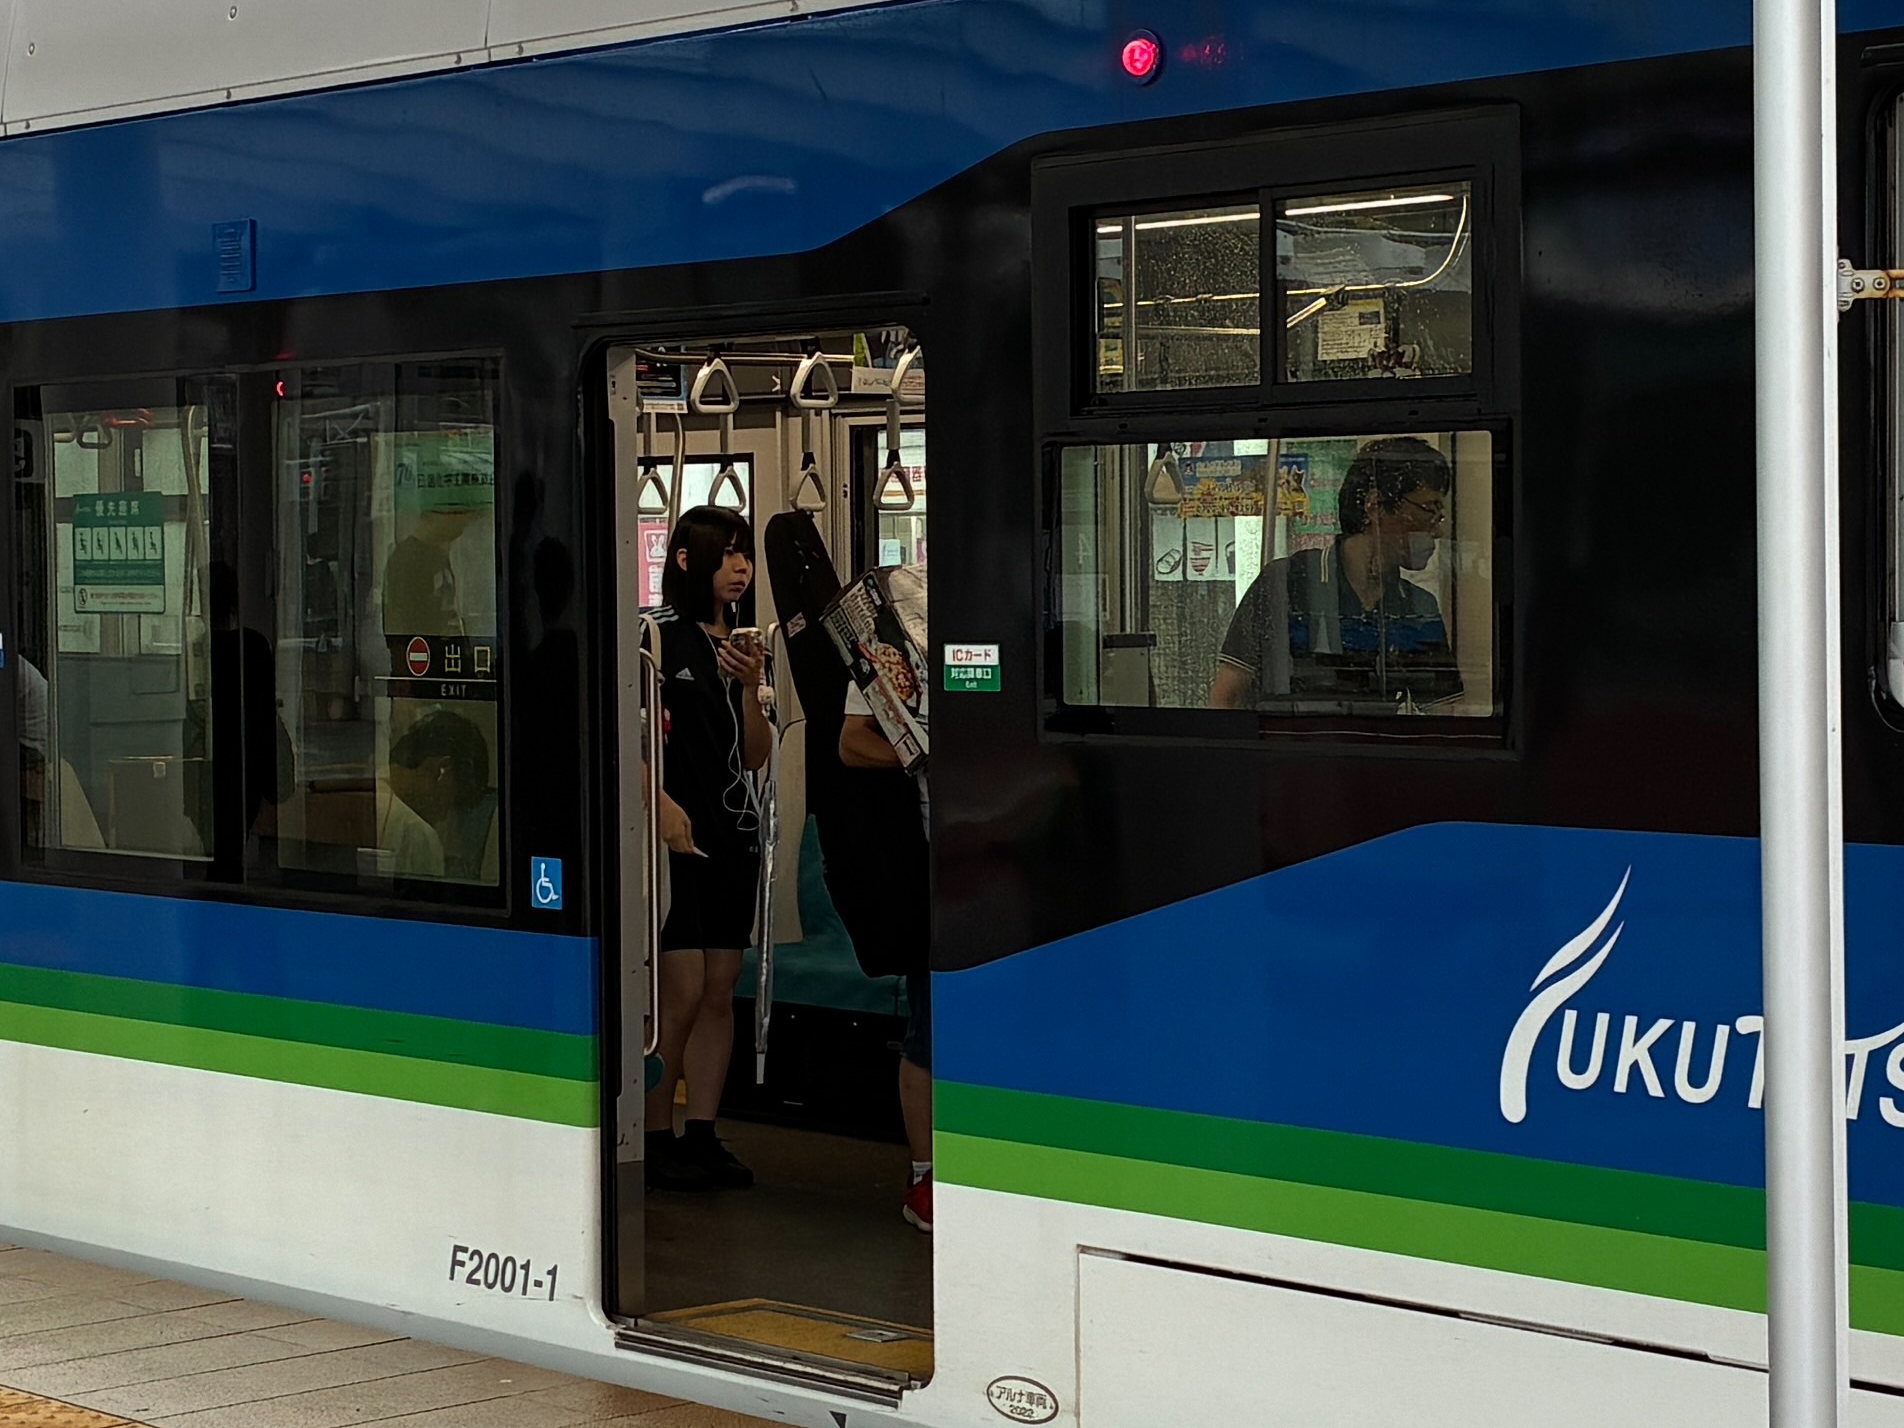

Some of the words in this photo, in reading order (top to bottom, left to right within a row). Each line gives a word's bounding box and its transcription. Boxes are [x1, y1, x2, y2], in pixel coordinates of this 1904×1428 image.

[444, 643, 491, 673] 出口
[952, 648, 992, 662] ICカード
[440, 683, 467, 698] EXIT
[448, 1243, 560, 1303] F2001-1
